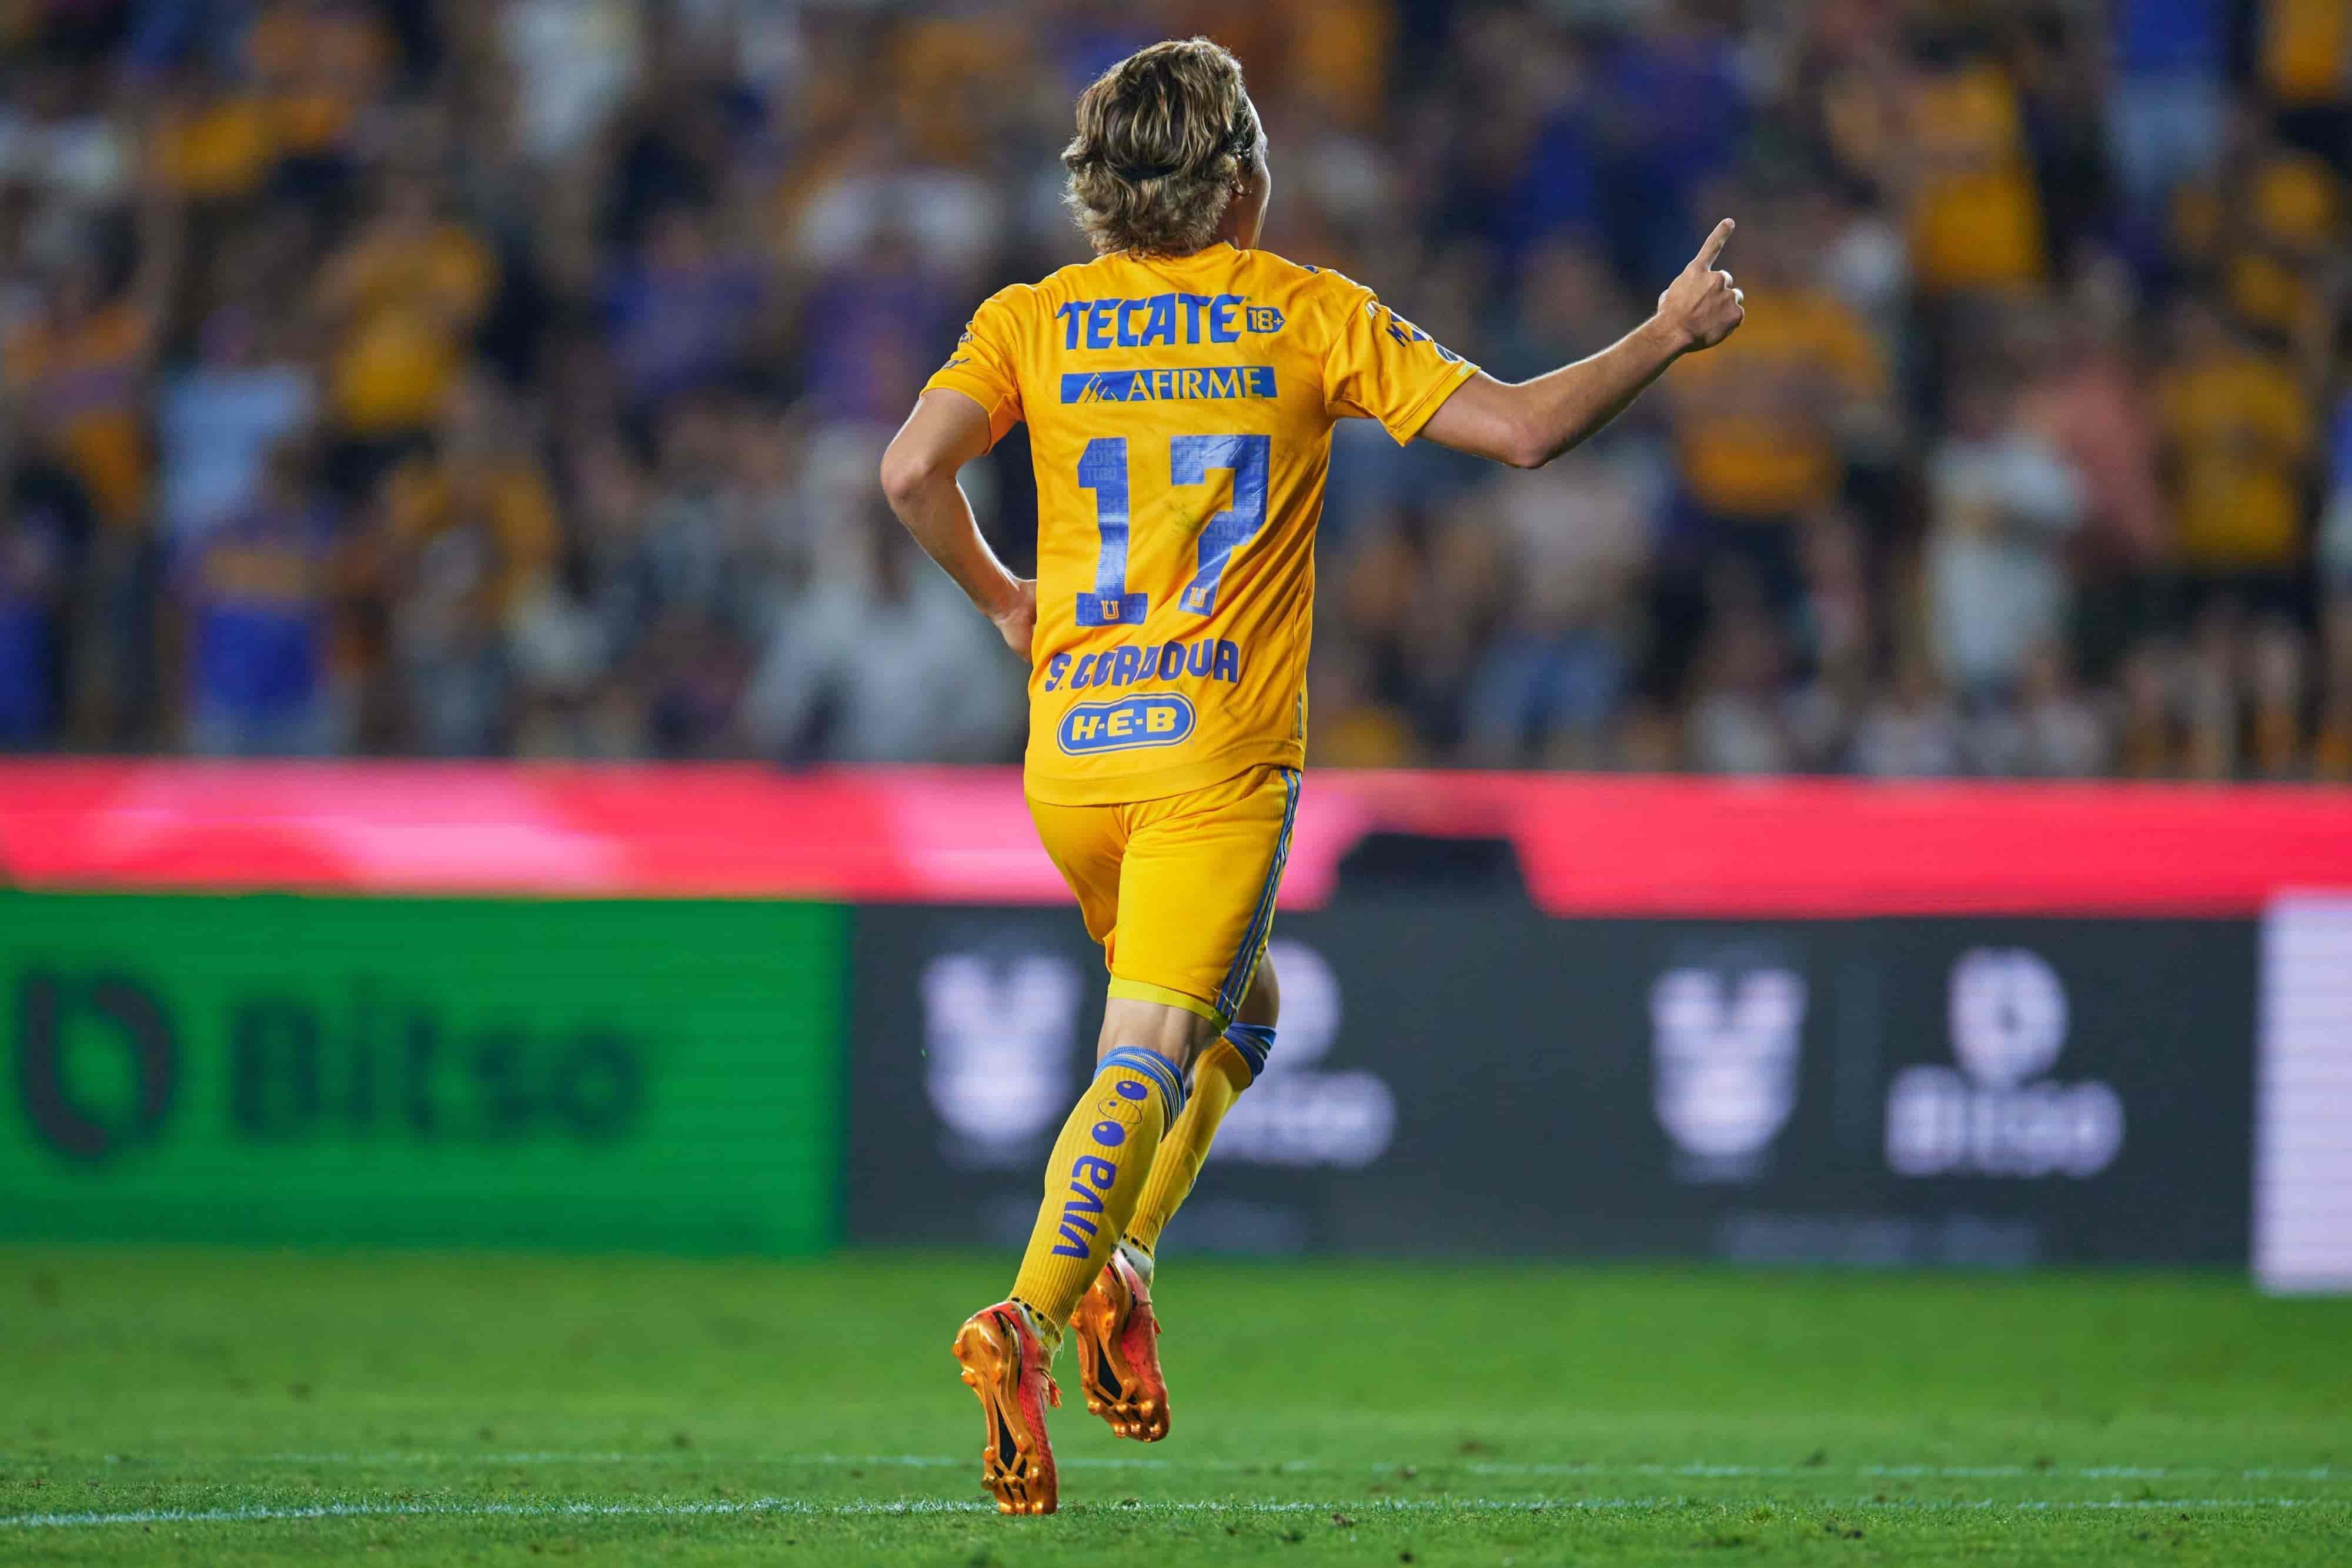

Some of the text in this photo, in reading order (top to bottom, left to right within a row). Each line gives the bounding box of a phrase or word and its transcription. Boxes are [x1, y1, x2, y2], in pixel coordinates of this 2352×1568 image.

[1055, 292, 1284, 350] TECATE 18+
[1126, 367, 1262, 400] AFIRME
[1075, 434, 1271, 627] 17
[1051, 1155, 1117, 1259] viva
